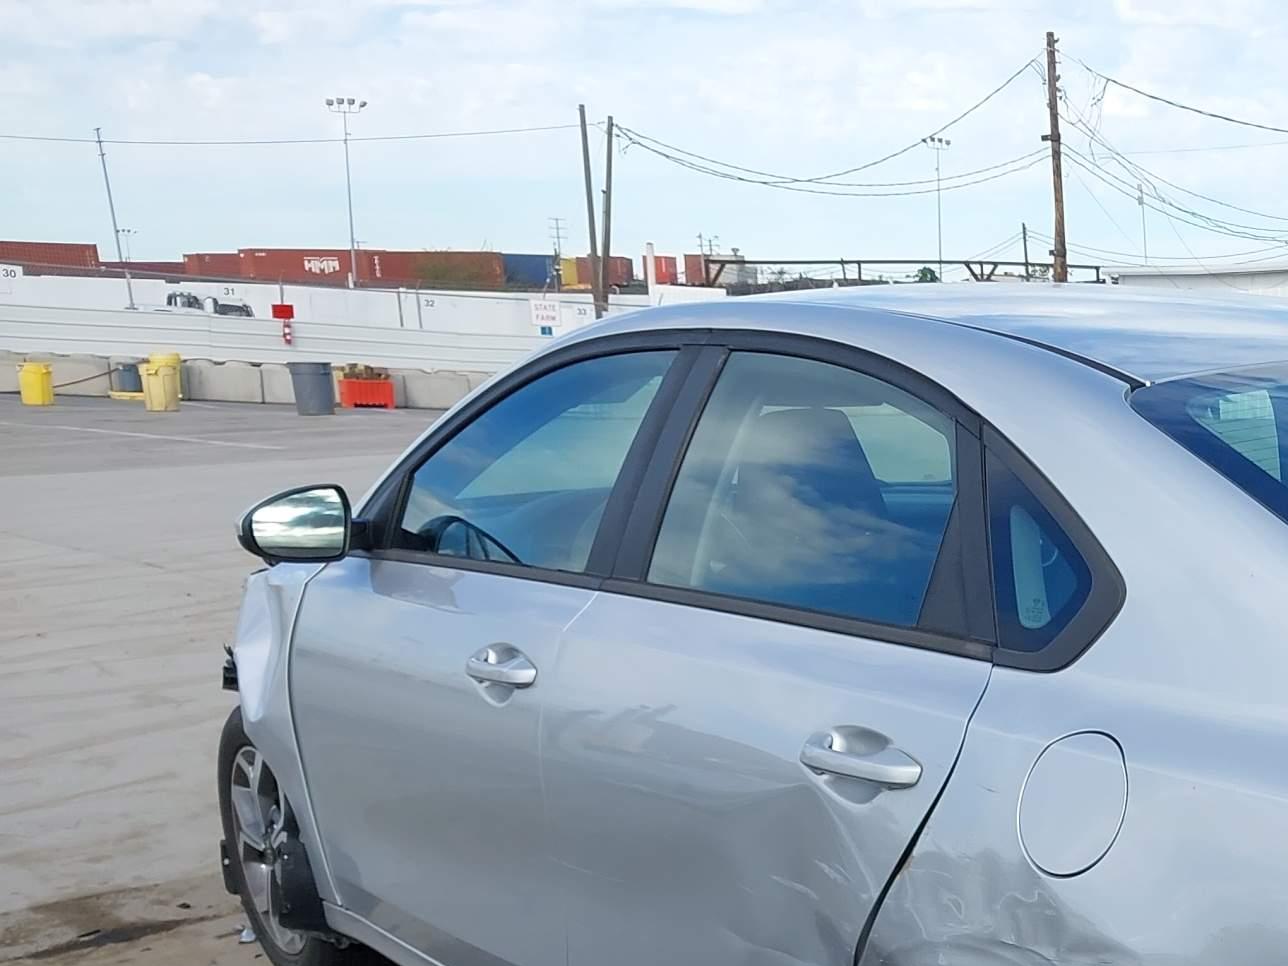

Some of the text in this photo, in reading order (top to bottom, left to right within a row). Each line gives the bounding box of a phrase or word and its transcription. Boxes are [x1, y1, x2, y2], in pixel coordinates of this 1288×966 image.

[303, 256, 340, 275] HMM
[2, 268, 17, 279] 30
[223, 287, 236, 297] 31
